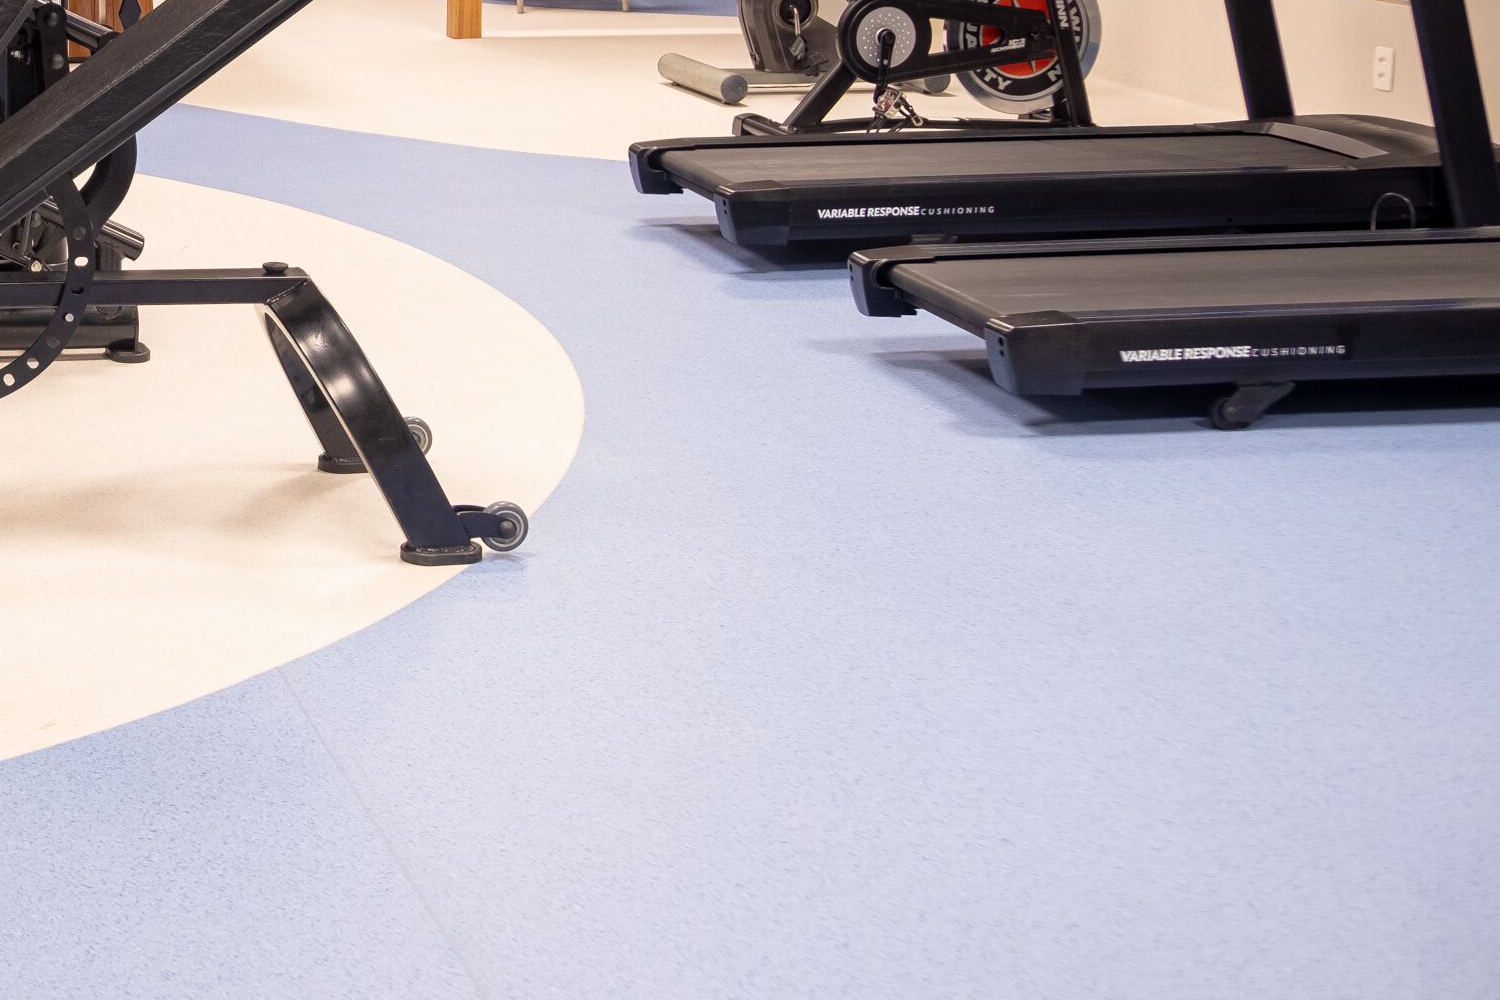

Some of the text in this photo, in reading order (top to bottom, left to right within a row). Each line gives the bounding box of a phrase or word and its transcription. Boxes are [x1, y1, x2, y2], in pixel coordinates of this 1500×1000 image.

[817, 206, 996, 219] VARIABLE RESPONSE CUSHIONING
[1119, 345, 1346, 362] VARIABLE RESPONSE CUSHIONING
